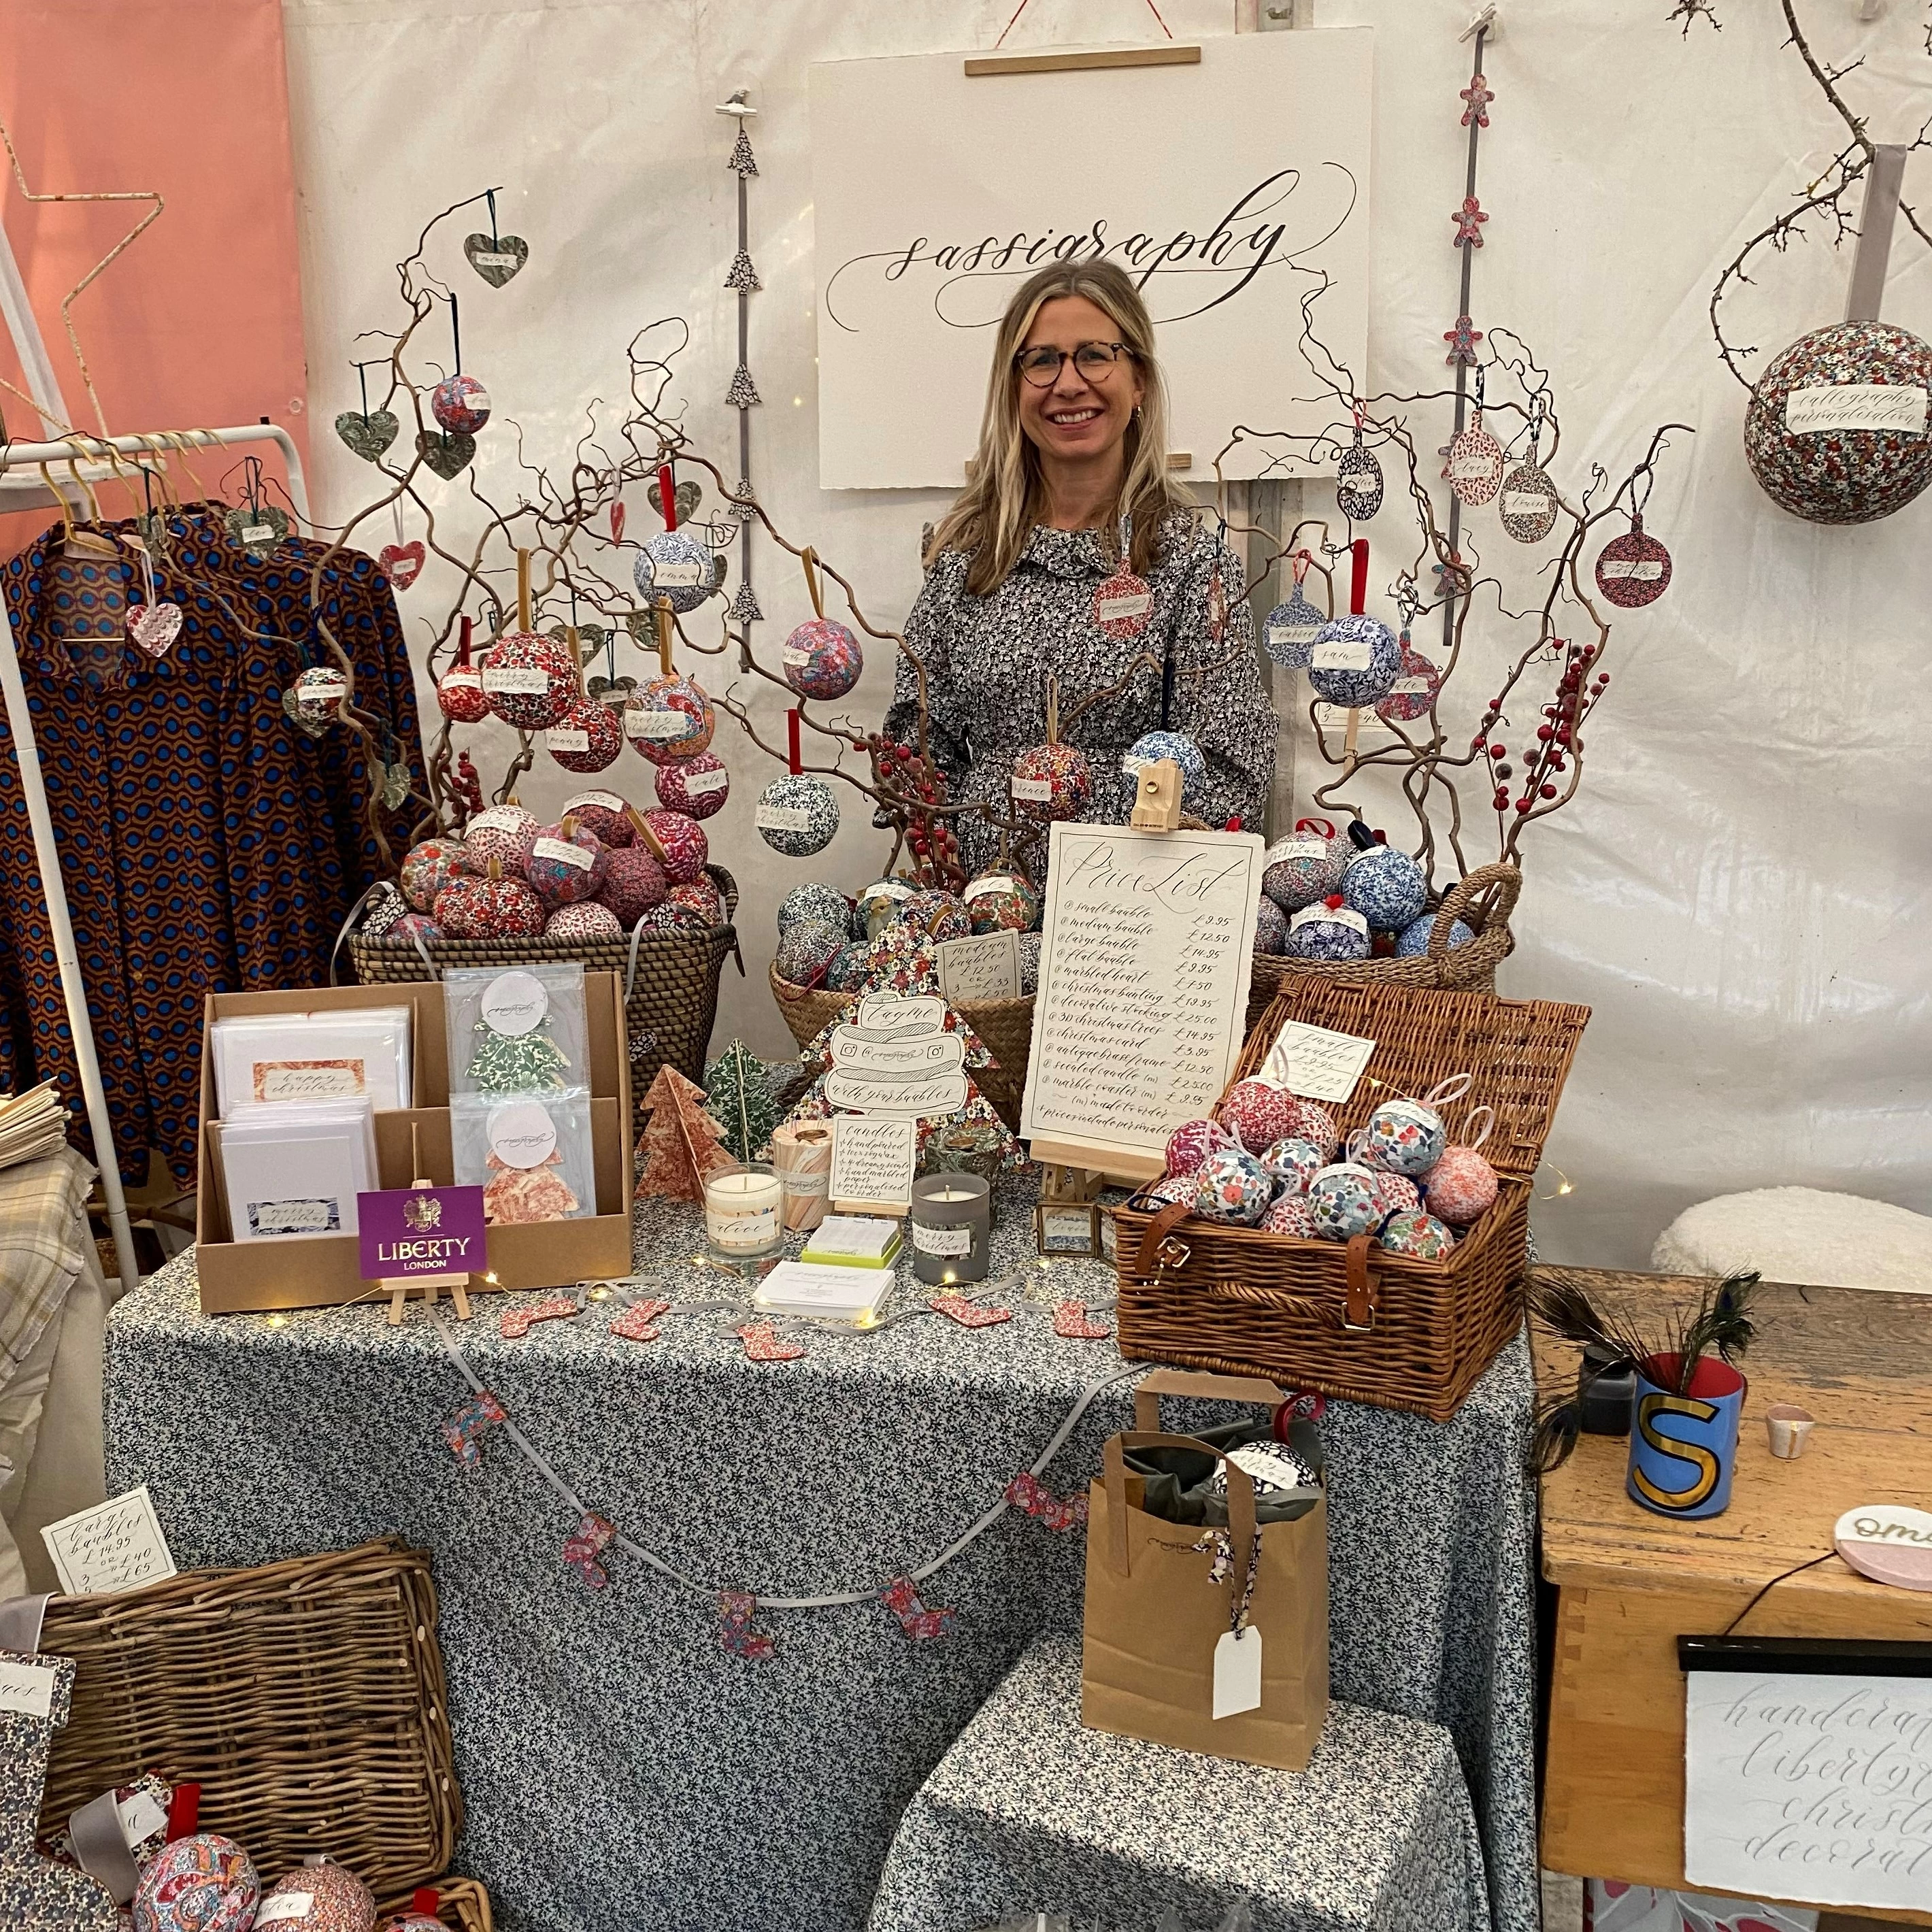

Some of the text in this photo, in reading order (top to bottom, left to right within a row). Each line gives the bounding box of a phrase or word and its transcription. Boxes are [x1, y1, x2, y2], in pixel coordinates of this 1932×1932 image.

[1796, 388, 1918, 409] calligraphy
[1142, 850, 1247, 912] List
[1075, 901, 1109, 914] small
[1108, 903, 1154, 918] bauble
[1069, 916, 1112, 931] medium
[1114, 920, 1154, 936] bauble
[952, 940, 1007, 955] medium
[1065, 932, 1097, 947] large
[1096, 934, 1140, 950] bauble
[947, 950, 1006, 969] baubles
[1064, 948, 1095, 963] flat
[1096, 950, 1137, 966] bauble
[1063, 964, 1114, 981] marbled
[1112, 968, 1153, 984] heart
[1062, 979, 1118, 997] christmas
[1118, 985, 1167, 1007] bunting
[1060, 994, 1120, 1013] decorative
[1120, 1003, 1173, 1022] stocking
[1059, 1011, 1076, 1022] 3D
[1075, 1011, 1131, 1031] christmas
[1129, 1020, 1165, 1036] trees
[1056, 1026, 1116, 1045] christmas
[1115, 1037, 1150, 1050] card
[1056, 1043, 1099, 1059] antique
[1098, 1048, 1129, 1064] brass
[1125, 1053, 1169, 1069] frame
[1053, 1059, 1097, 1075] scented
[1097, 1065, 1139, 1080] candle
[1144, 1073, 1159, 1084] (m)
[1052, 1075, 1095, 1091] marble
[1094, 1082, 1139, 1099] coaster
[1141, 1088, 1157, 1101] (m)
[845, 1122, 909, 1139] candles
[378, 1236, 471, 1261] LIBERTY
[403, 1259, 447, 1270] LONDON
[1633, 1393, 1720, 1512] S
[1772, 1786, 1932, 1835] christ
